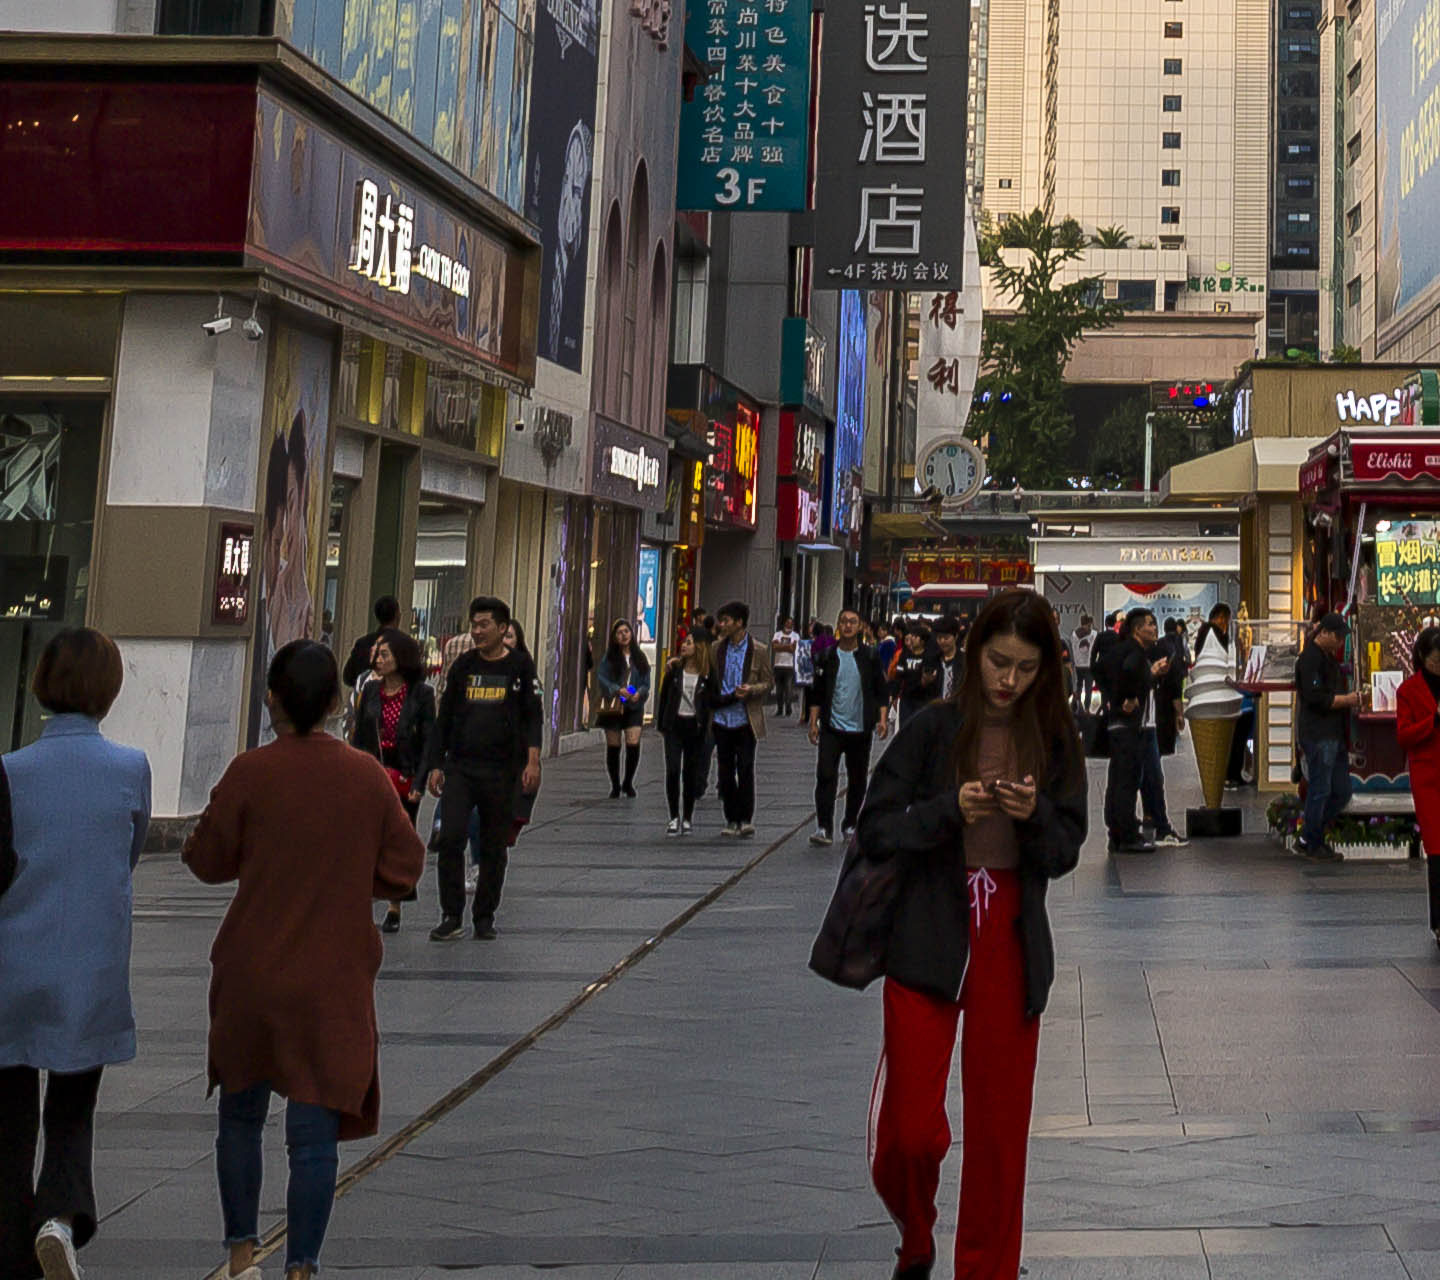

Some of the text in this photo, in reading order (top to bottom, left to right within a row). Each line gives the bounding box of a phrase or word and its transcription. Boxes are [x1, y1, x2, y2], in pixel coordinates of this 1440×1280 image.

[715, 167, 767, 206] 3F
[355, 179, 414, 295] 周大福
[928, 292, 964, 396] 得利
[1335, 388, 1402, 427] HAPP
